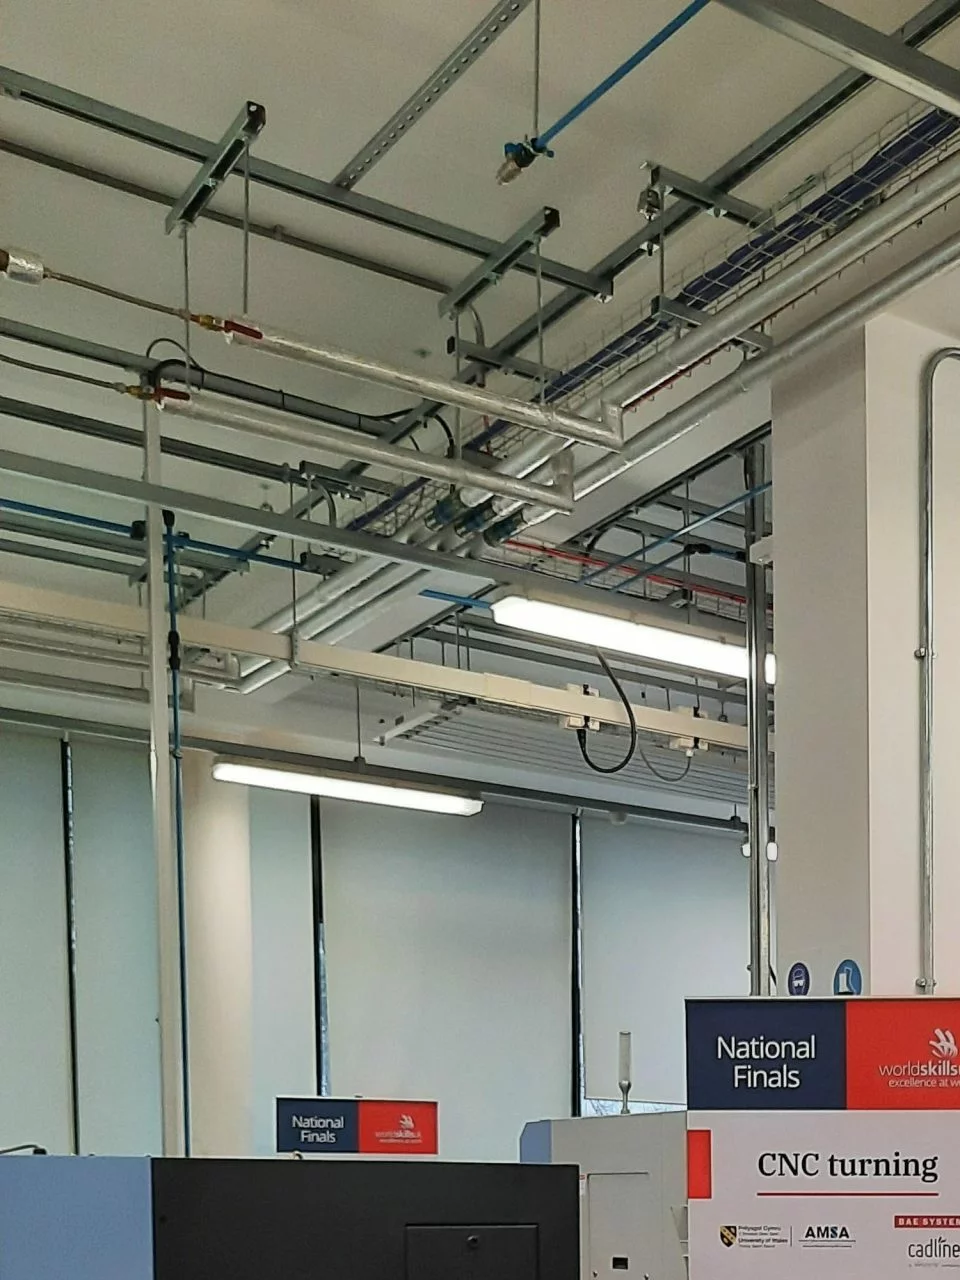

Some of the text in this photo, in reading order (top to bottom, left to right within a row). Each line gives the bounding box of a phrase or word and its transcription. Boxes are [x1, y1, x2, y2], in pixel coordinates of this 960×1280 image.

[717, 1034, 816, 1060] National
[733, 1064, 801, 1089] Finals
[888, 1078, 937, 1088] excellence
[938, 1078, 949, 1088] at
[292, 1115, 345, 1129] National
[300, 1130, 337, 1143] Finals
[757, 1151, 939, 1183] CNC turning
[899, 1218, 919, 1226] BAE
[804, 1226, 850, 1239] AMSA
[908, 1236, 960, 1258] cadline
